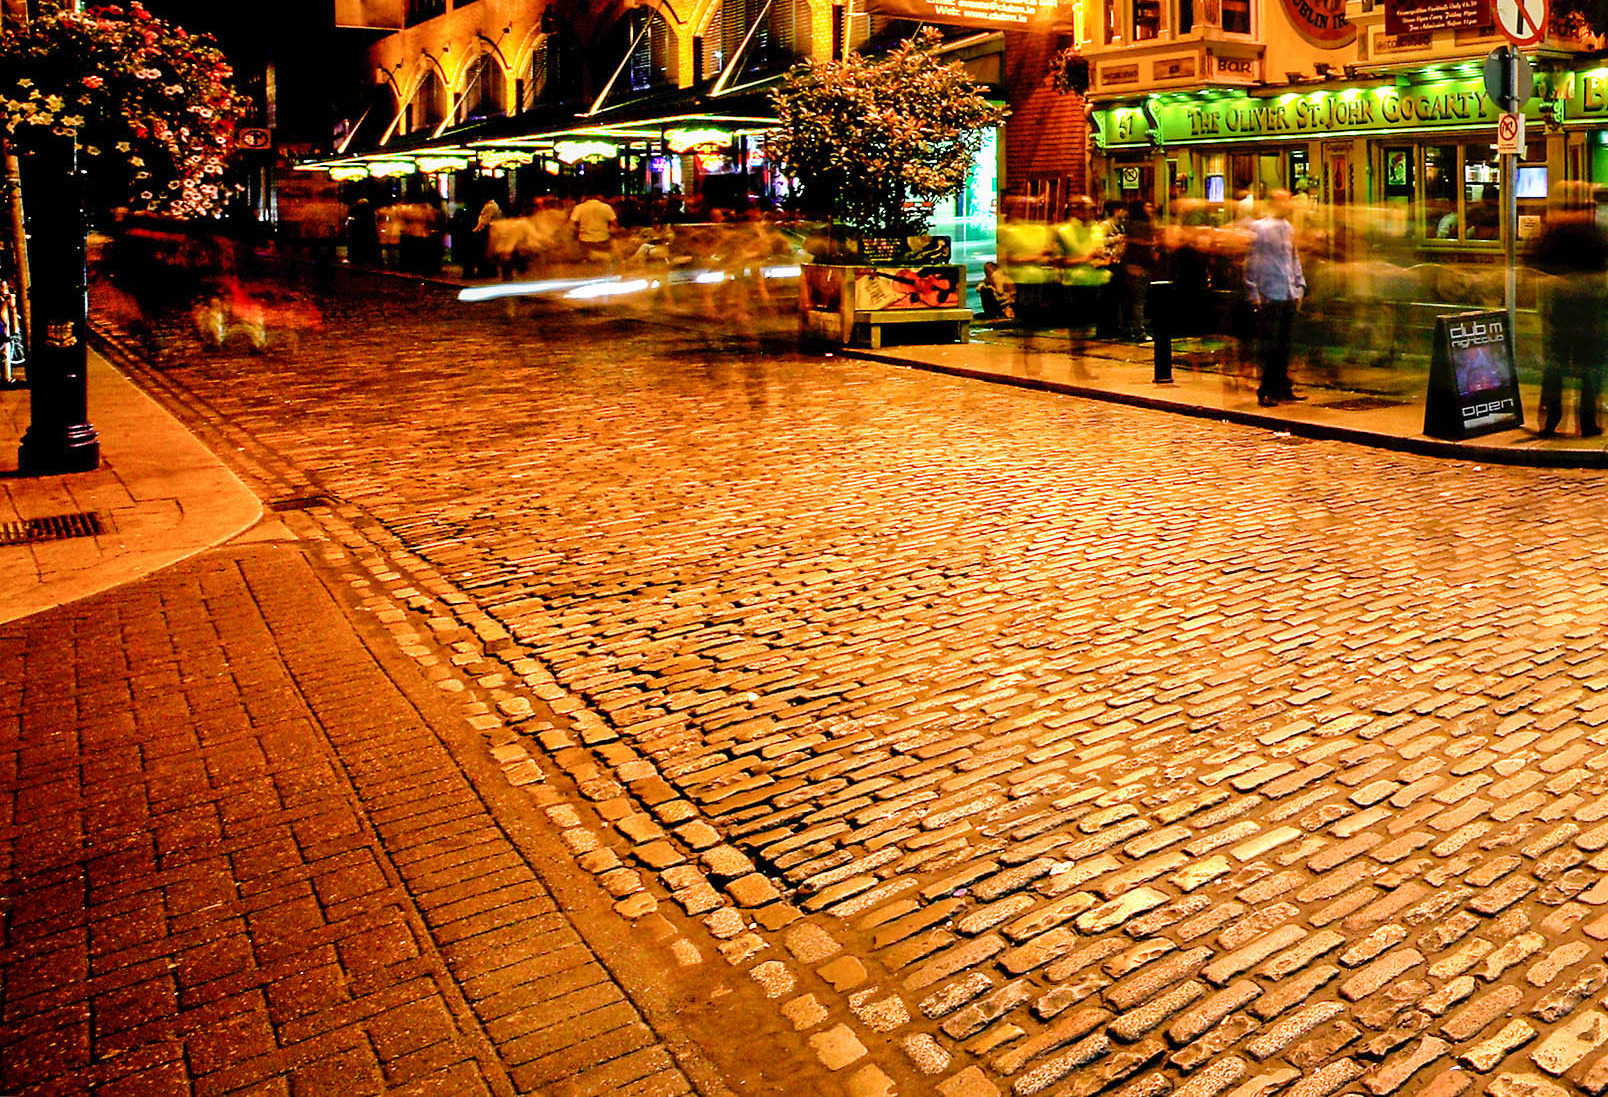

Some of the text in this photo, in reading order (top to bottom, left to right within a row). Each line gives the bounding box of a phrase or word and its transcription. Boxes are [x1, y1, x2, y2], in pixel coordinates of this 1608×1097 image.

[1188, 109, 1220, 136] THE
[1225, 107, 1290, 132] OLIVER
[1380, 90, 1490, 122] GOGARTY
[1450, 321, 1503, 339] club m
[1452, 334, 1504, 348] nightclub
[1462, 398, 1514, 417] open
